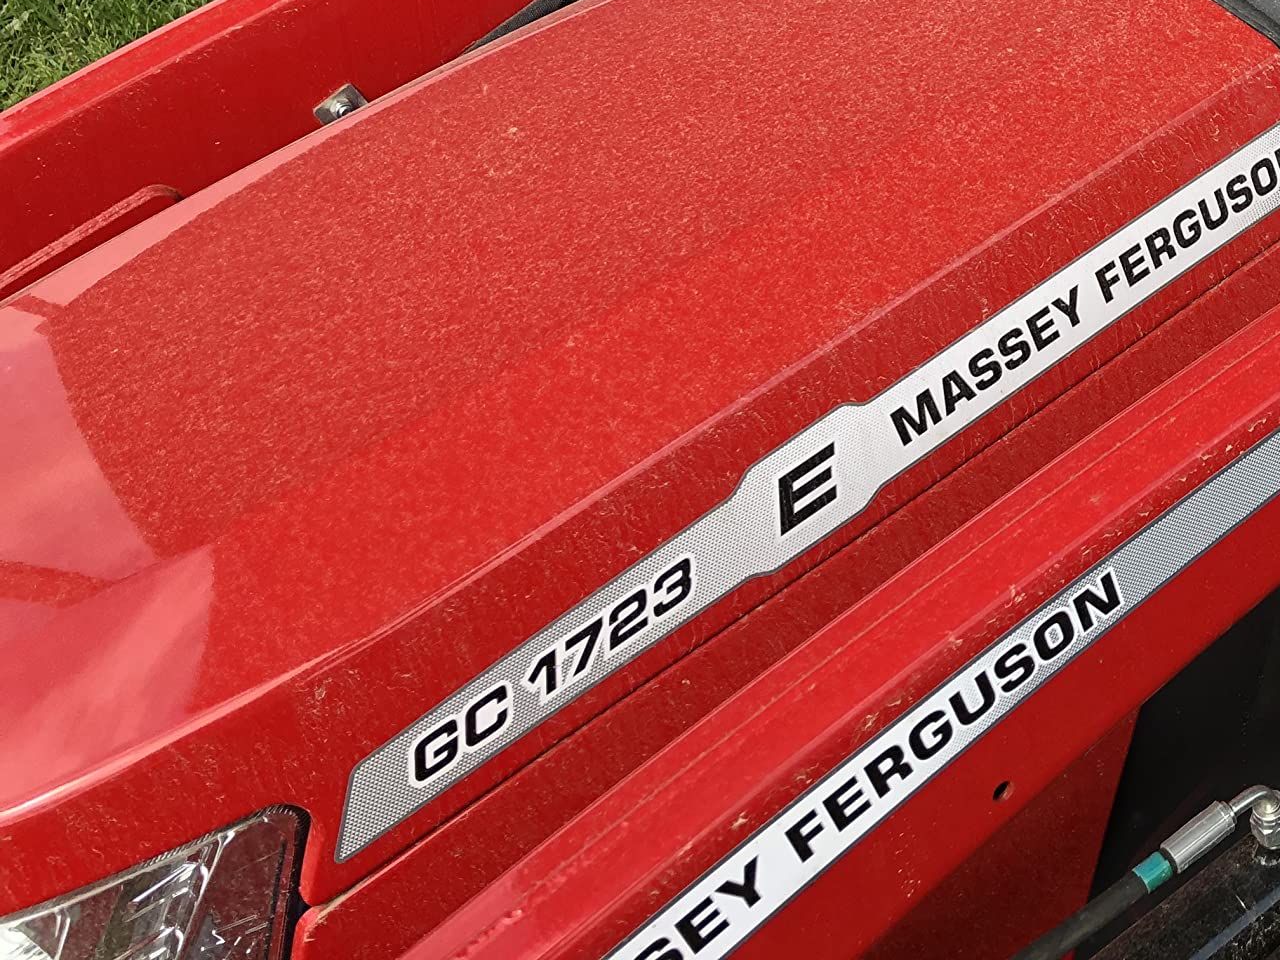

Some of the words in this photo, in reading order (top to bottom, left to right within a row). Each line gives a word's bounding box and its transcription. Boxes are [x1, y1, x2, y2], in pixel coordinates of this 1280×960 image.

[888, 284, 1082, 447] MASSEY
[414, 684, 509, 782] GC
[527, 557, 692, 696] 1723
[777, 442, 837, 537] E
[785, 571, 1124, 865] FERGUSON
